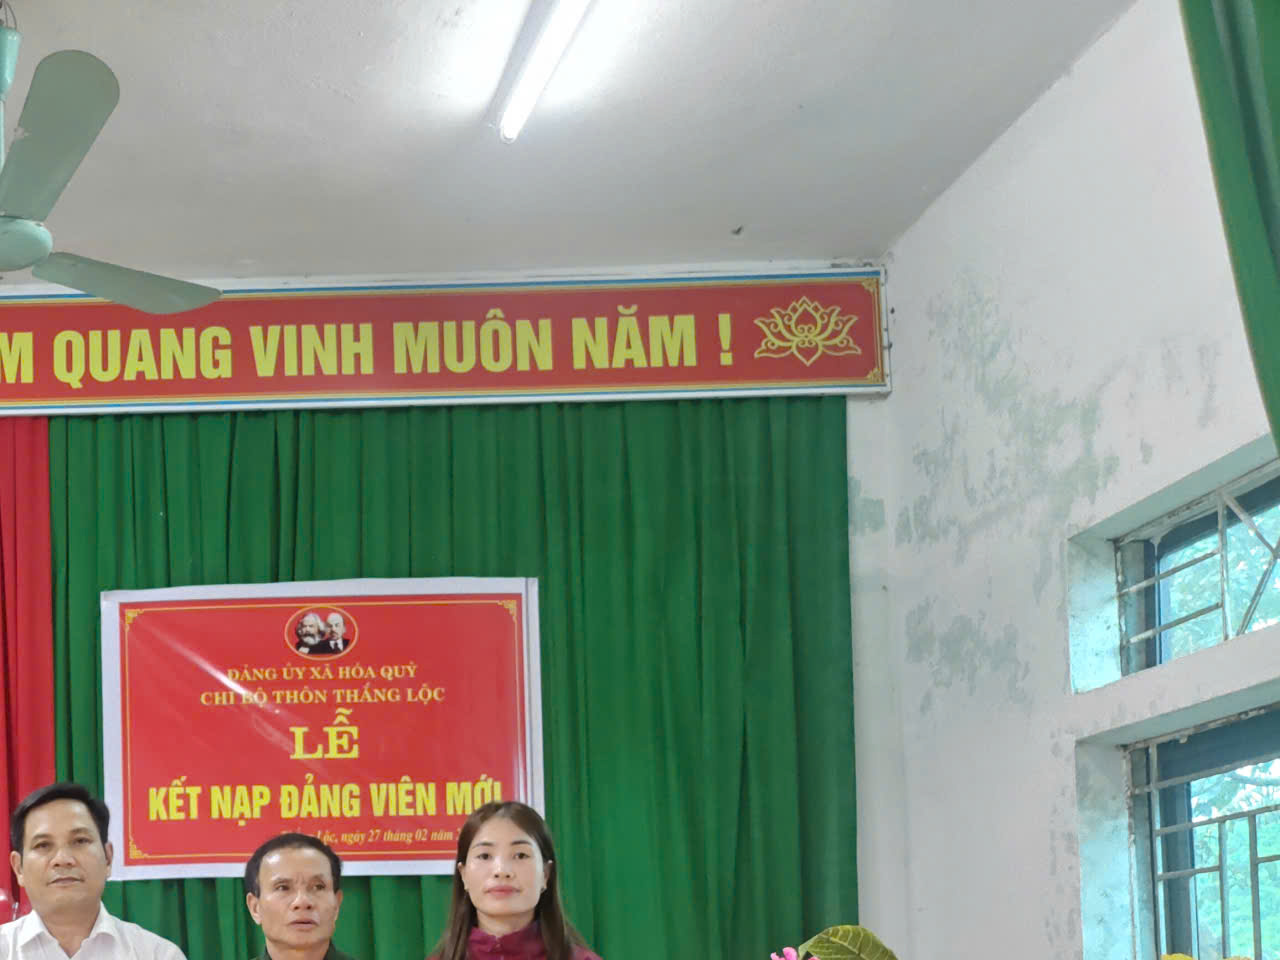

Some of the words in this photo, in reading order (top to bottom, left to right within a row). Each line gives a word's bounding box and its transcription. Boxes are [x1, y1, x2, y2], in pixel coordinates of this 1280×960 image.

[53, 326, 232, 389] QUANG
[249, 322, 374, 377] VINH
[393, 308, 553, 374] MUÔN
[571, 304, 697, 370] NĂM
[718, 313, 733, 366] !
[227, 664, 277, 681] ĐẢNG
[310, 663, 336, 679] XÃ
[241, 686, 268, 708] BỘ
[272, 686, 327, 704] THÔN
[333, 682, 401, 703] THẮNG
[407, 683, 446, 704] LỘC
[289, 707, 360, 760] LỄ
[148, 776, 202, 821] KẾT
[210, 785, 271, 827] NẠP
[280, 773, 361, 819] ĐẢNG
[370, 775, 436, 817] VIÊN
[446, 774, 502, 815] MỚI
[341, 829, 366, 845] ngày
[368, 829, 381, 842] 27
[383, 829, 413, 845] tháng
[415, 828, 428, 841] 02
[431, 829, 453, 841] năm
